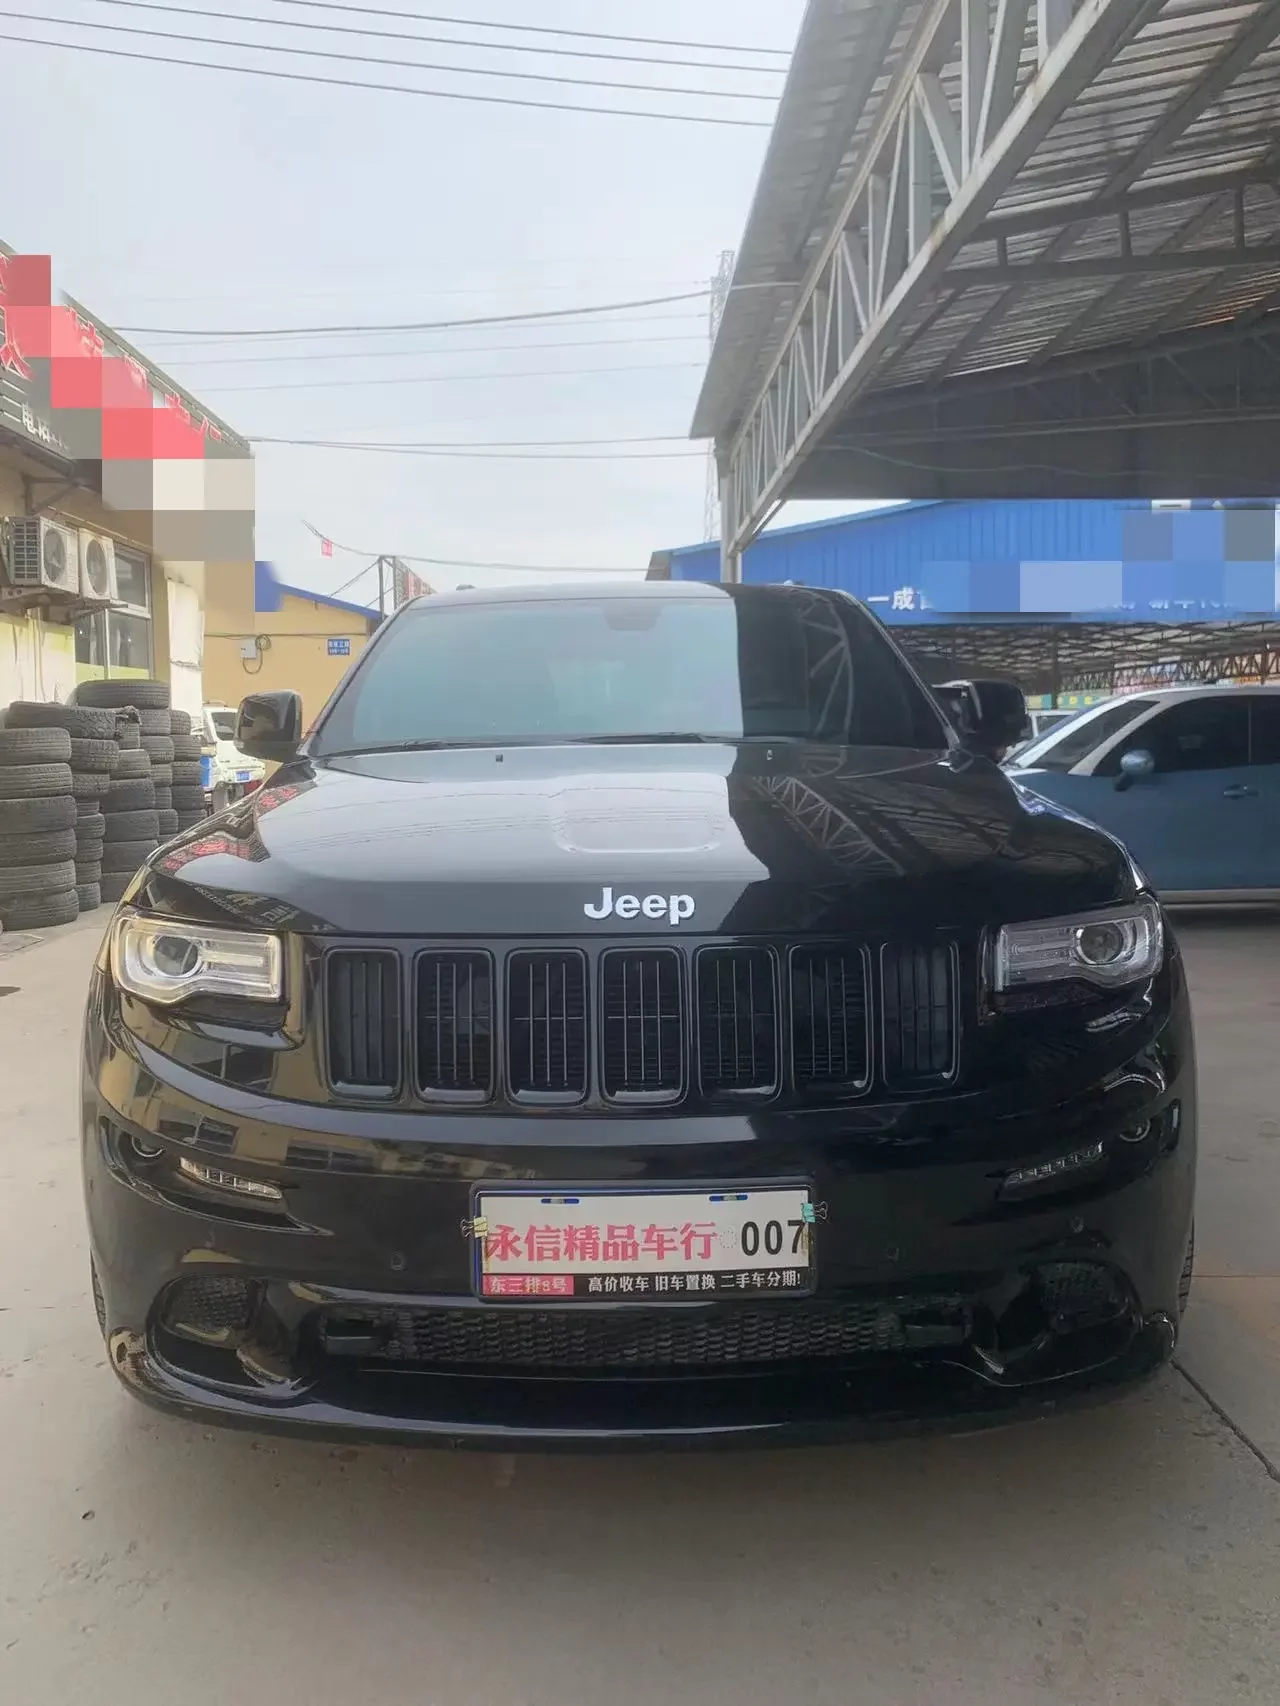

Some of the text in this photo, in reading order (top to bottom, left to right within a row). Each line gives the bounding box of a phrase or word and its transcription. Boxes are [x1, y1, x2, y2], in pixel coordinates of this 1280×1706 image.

[584, 887, 695, 925] Jeep
[487, 1219, 806, 1262] 永信精品车行 007
[588, 1275, 650, 1292] 高价收车
[655, 1274, 716, 1291] 旧车置换
